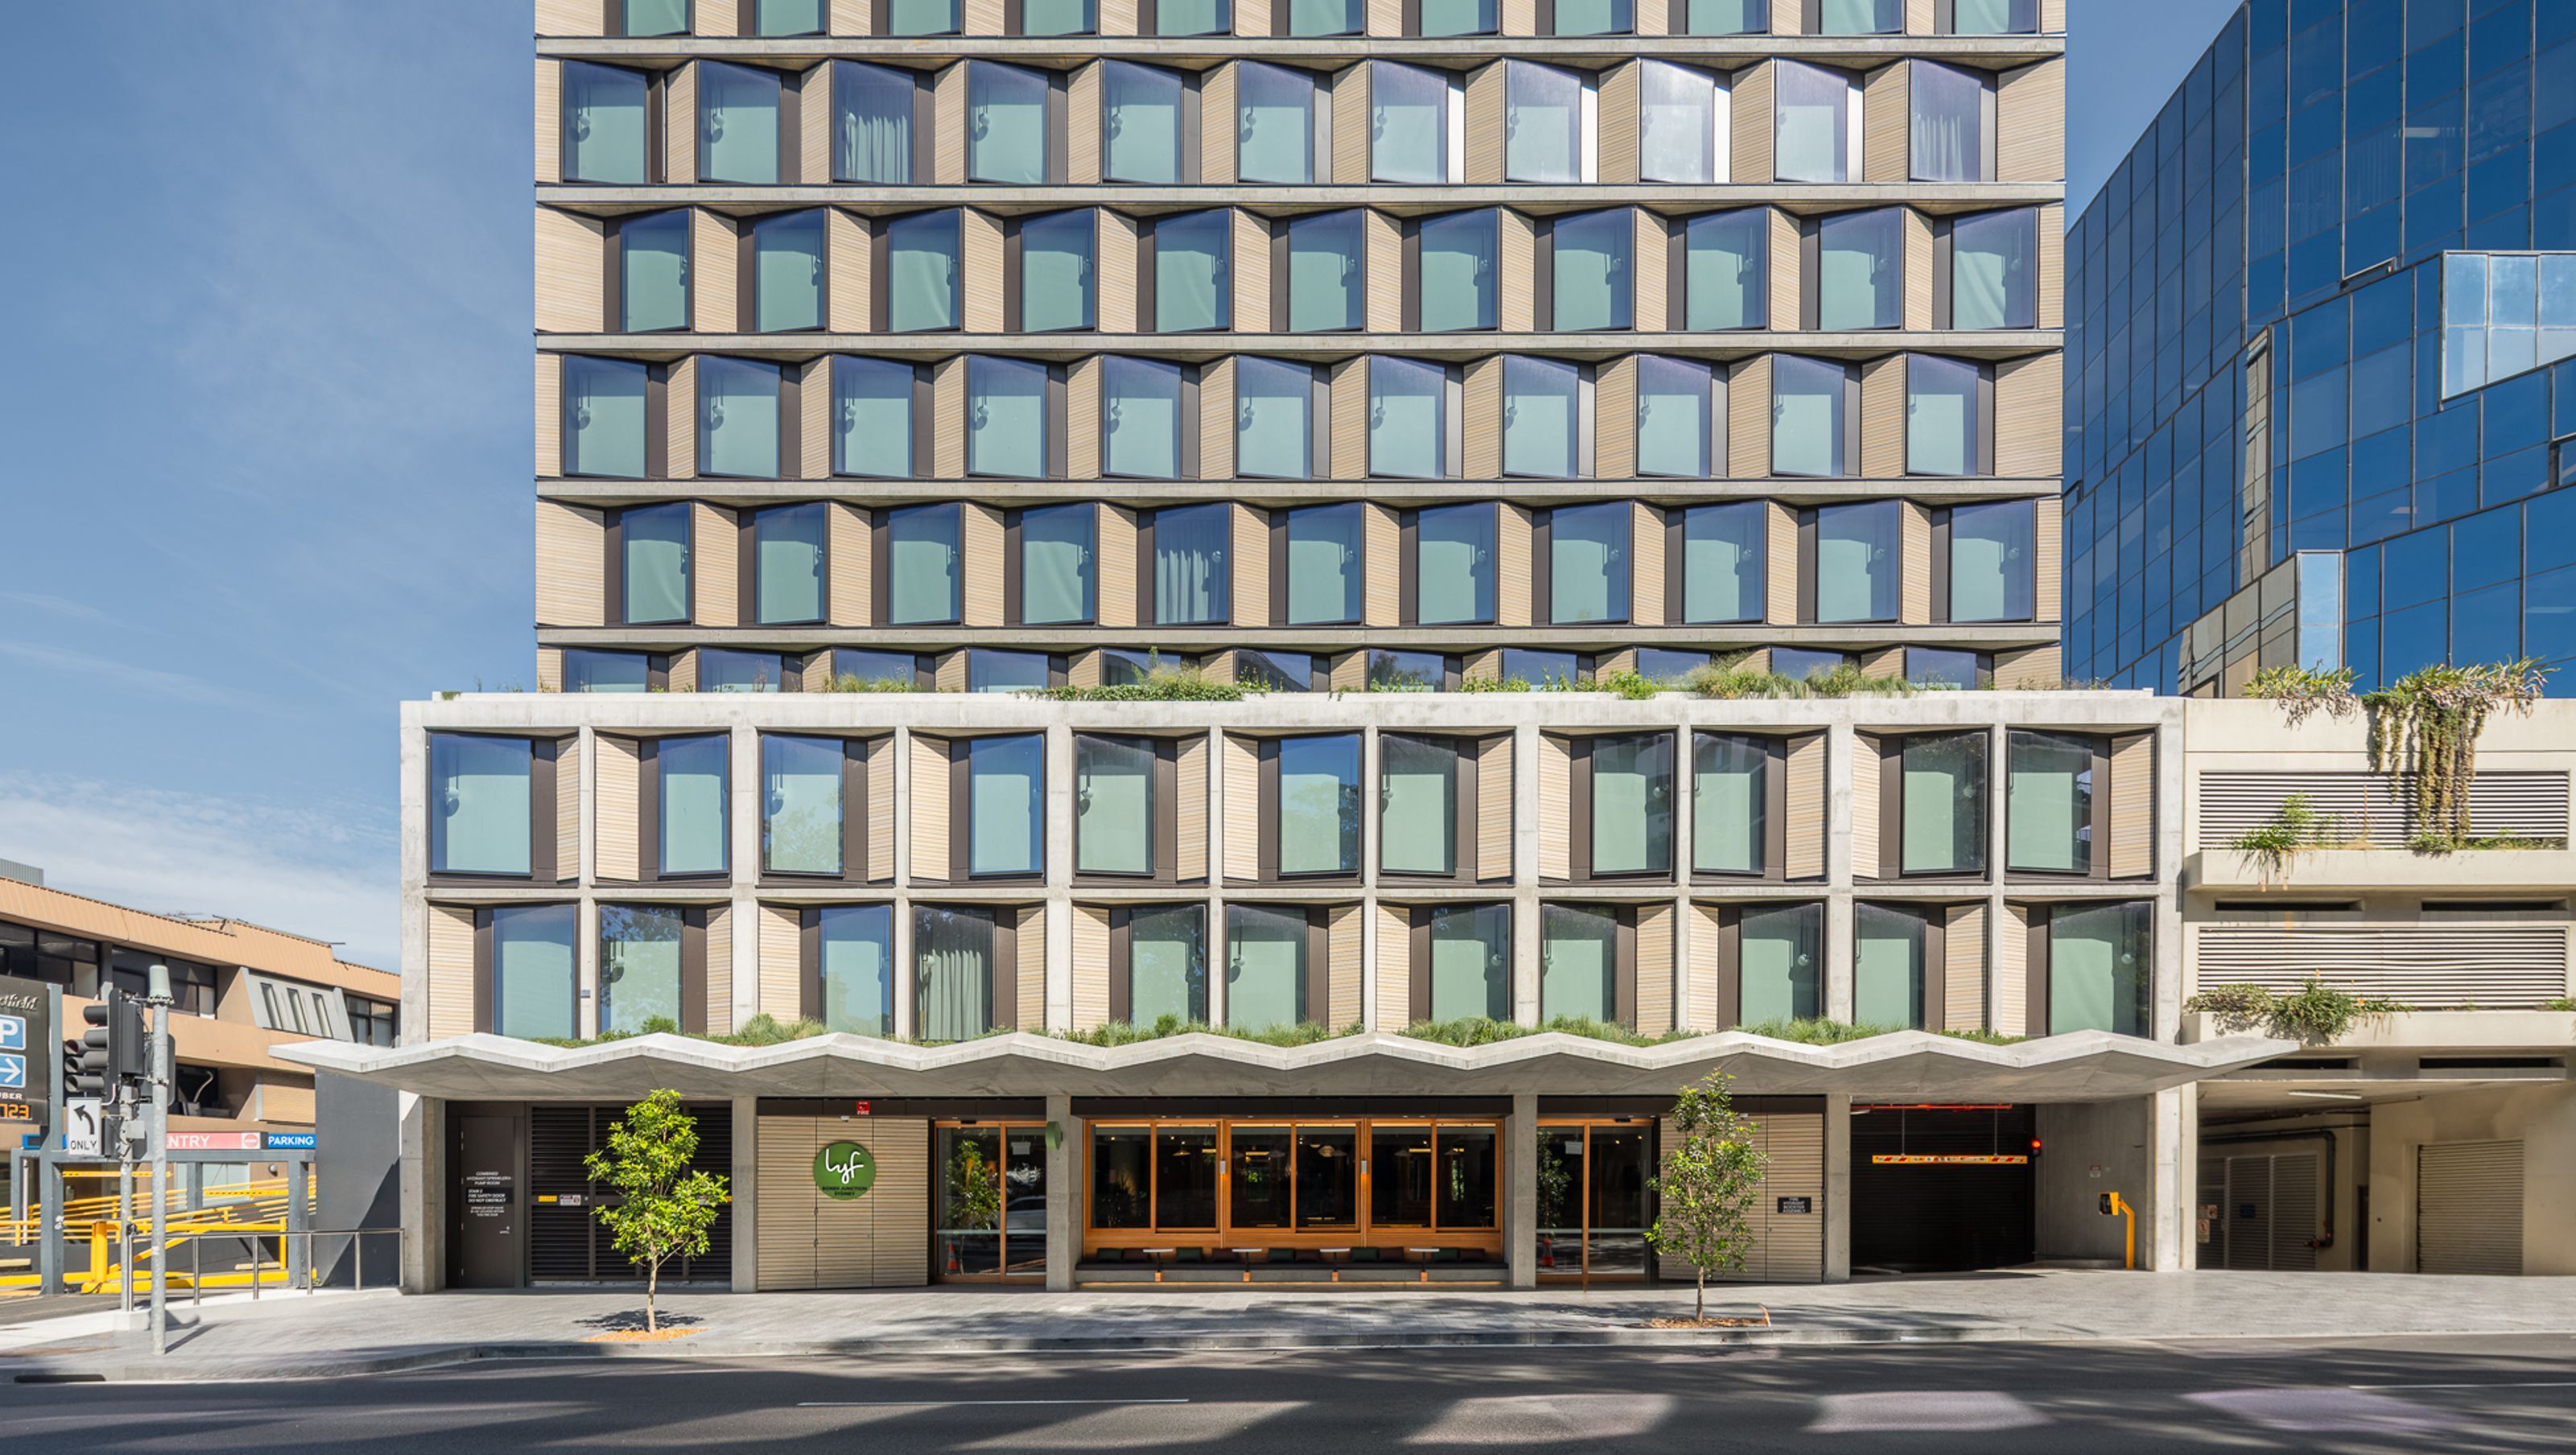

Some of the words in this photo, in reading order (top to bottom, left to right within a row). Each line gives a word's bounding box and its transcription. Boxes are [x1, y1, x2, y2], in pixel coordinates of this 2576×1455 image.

[0, 1020, 19, 1044] P
[0, 1092, 23, 1100] BER
[70, 1140, 97, 1151] ONLY
[167, 1135, 210, 1147] NTRY
[268, 1135, 314, 1146] PARKING
[825, 1148, 864, 1184] lyf
